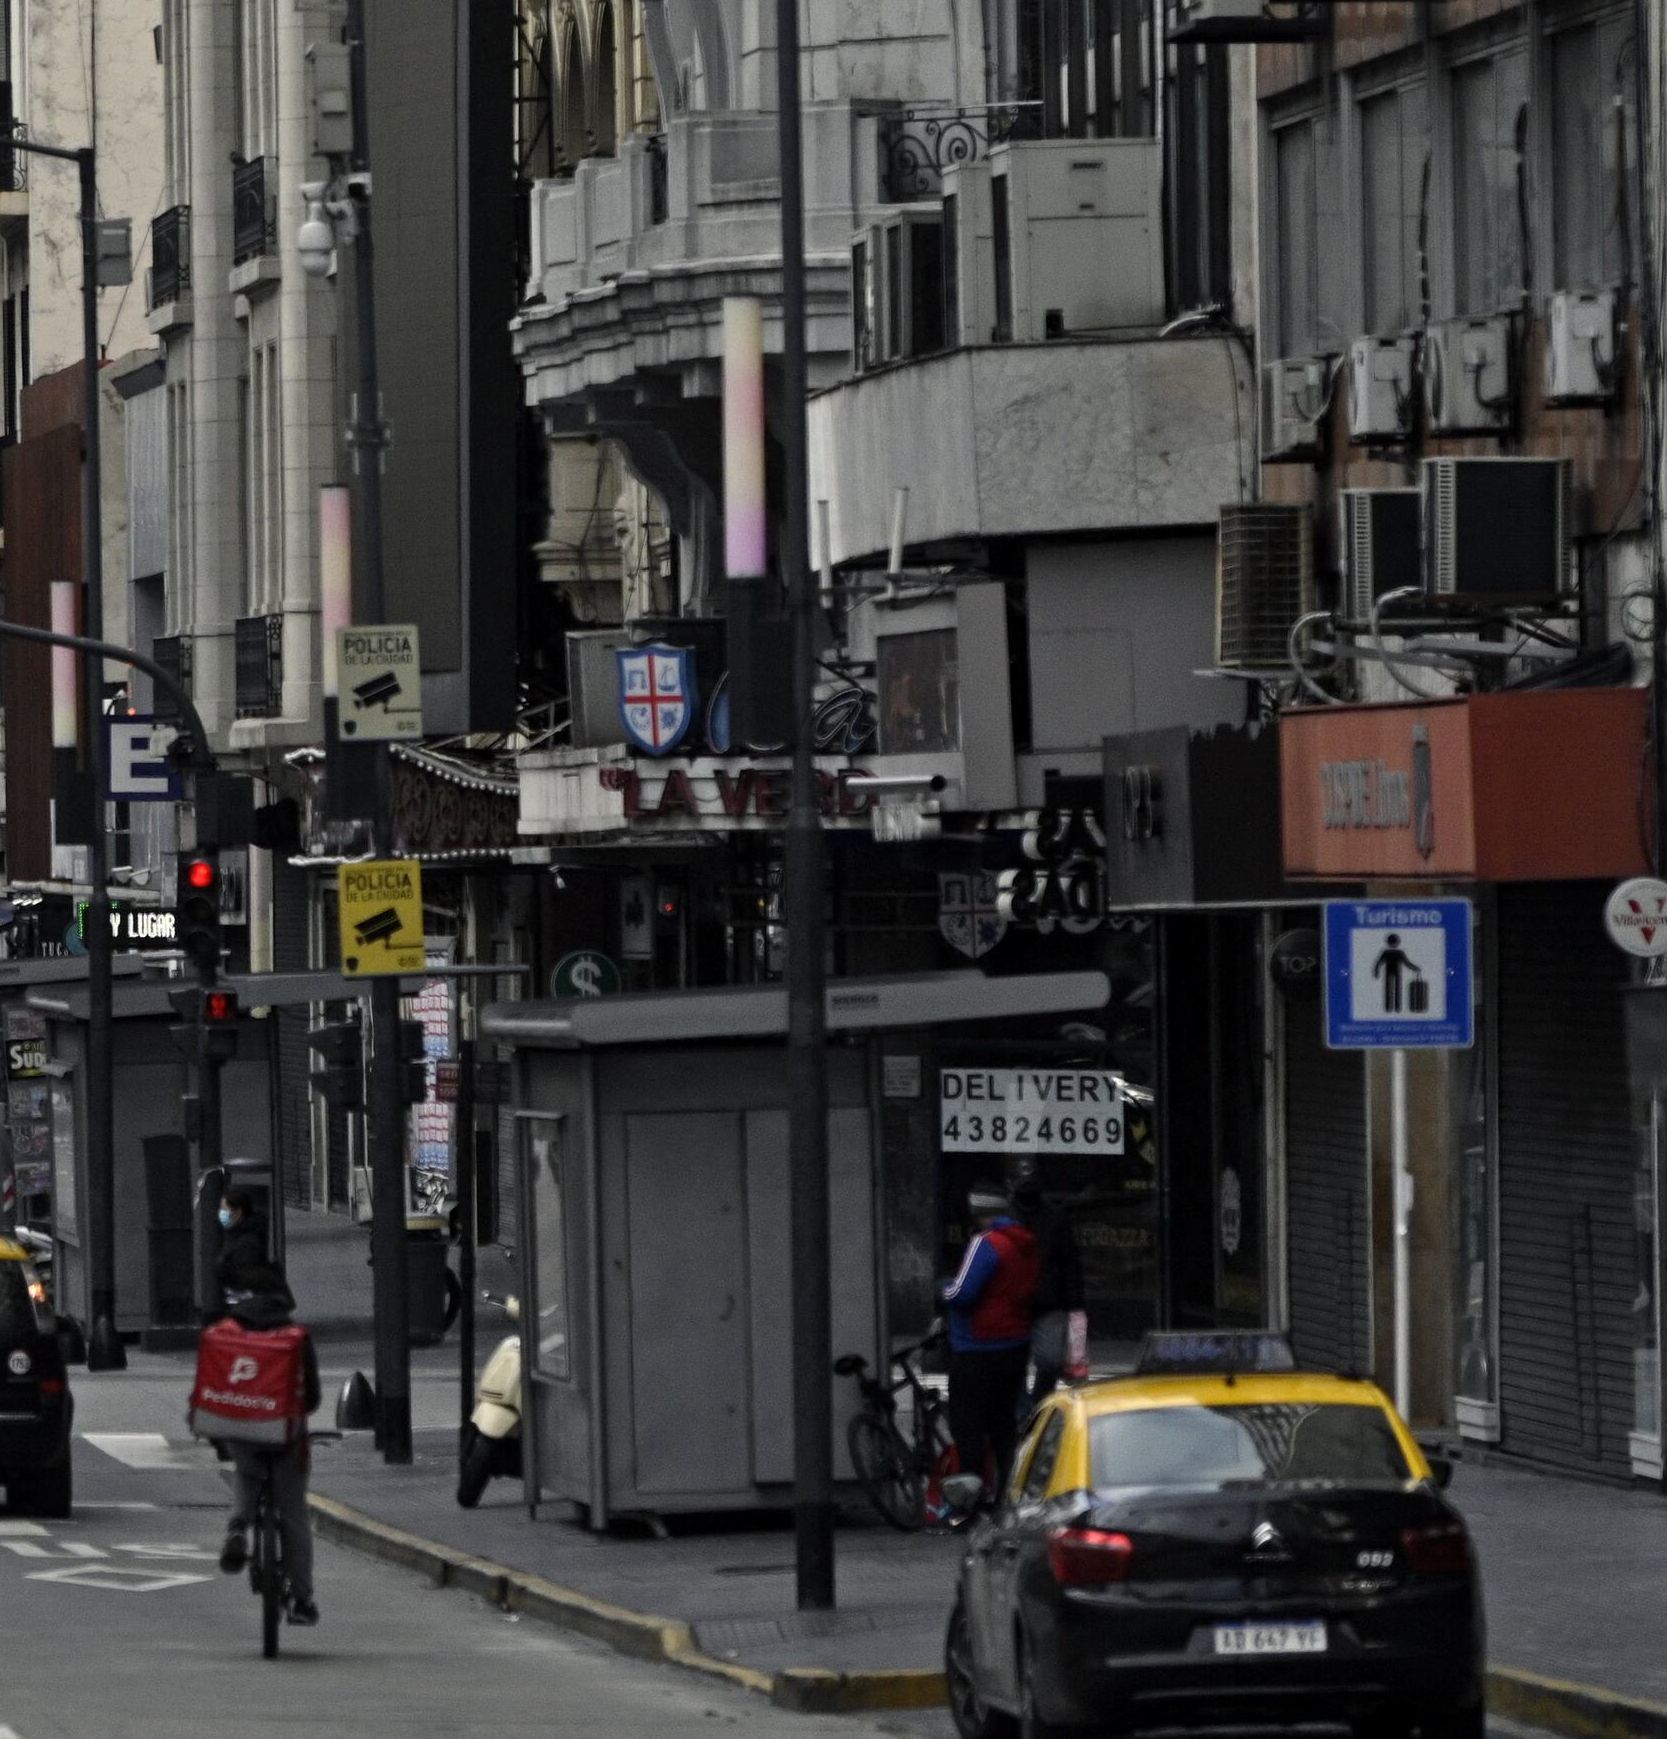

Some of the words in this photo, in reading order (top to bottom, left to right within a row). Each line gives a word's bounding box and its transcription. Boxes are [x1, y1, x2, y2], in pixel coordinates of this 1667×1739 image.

[127, 912, 177, 939] LUGAR
[1355, 907, 1443, 925] Turismo
[943, 1115, 1121, 1144] 43824669
